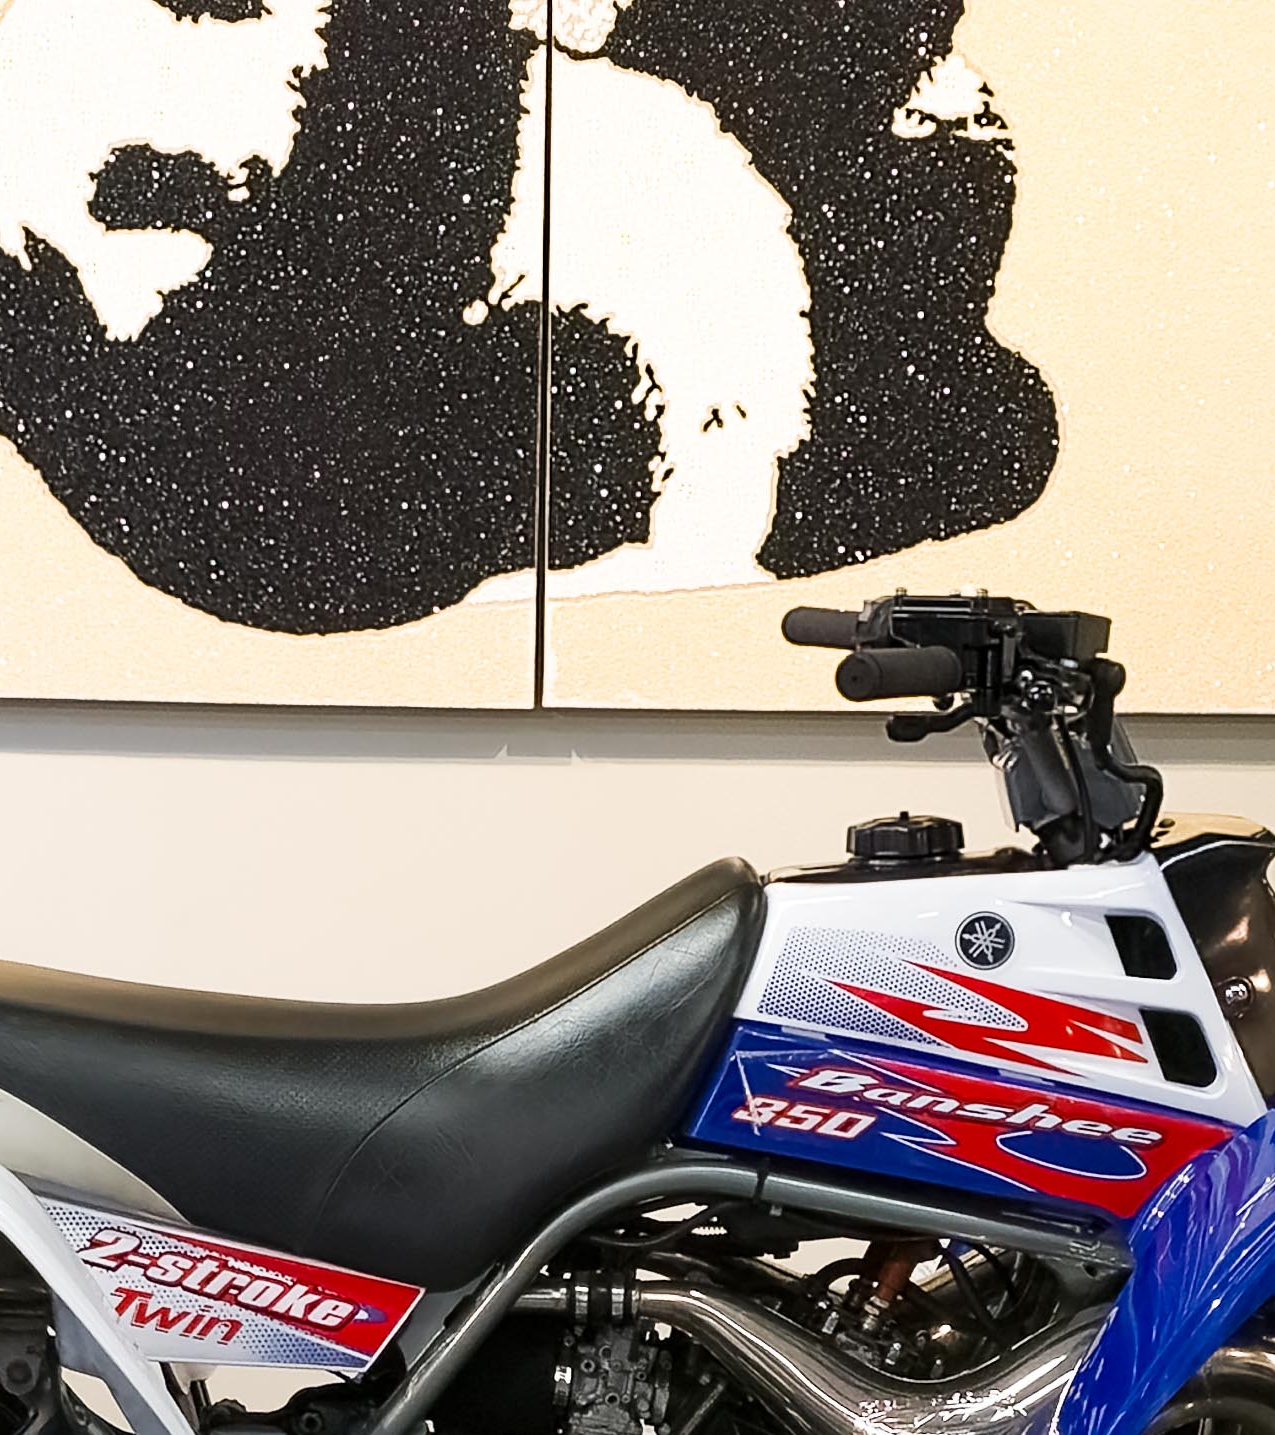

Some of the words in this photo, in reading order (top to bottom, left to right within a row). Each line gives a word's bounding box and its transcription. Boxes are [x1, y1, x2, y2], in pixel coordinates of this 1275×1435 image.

[733, 1096, 877, 1139] 350
[793, 1067, 1164, 1146] Banshee
[78, 1228, 359, 1332] 2-stroke
[111, 1286, 244, 1346] Twin
